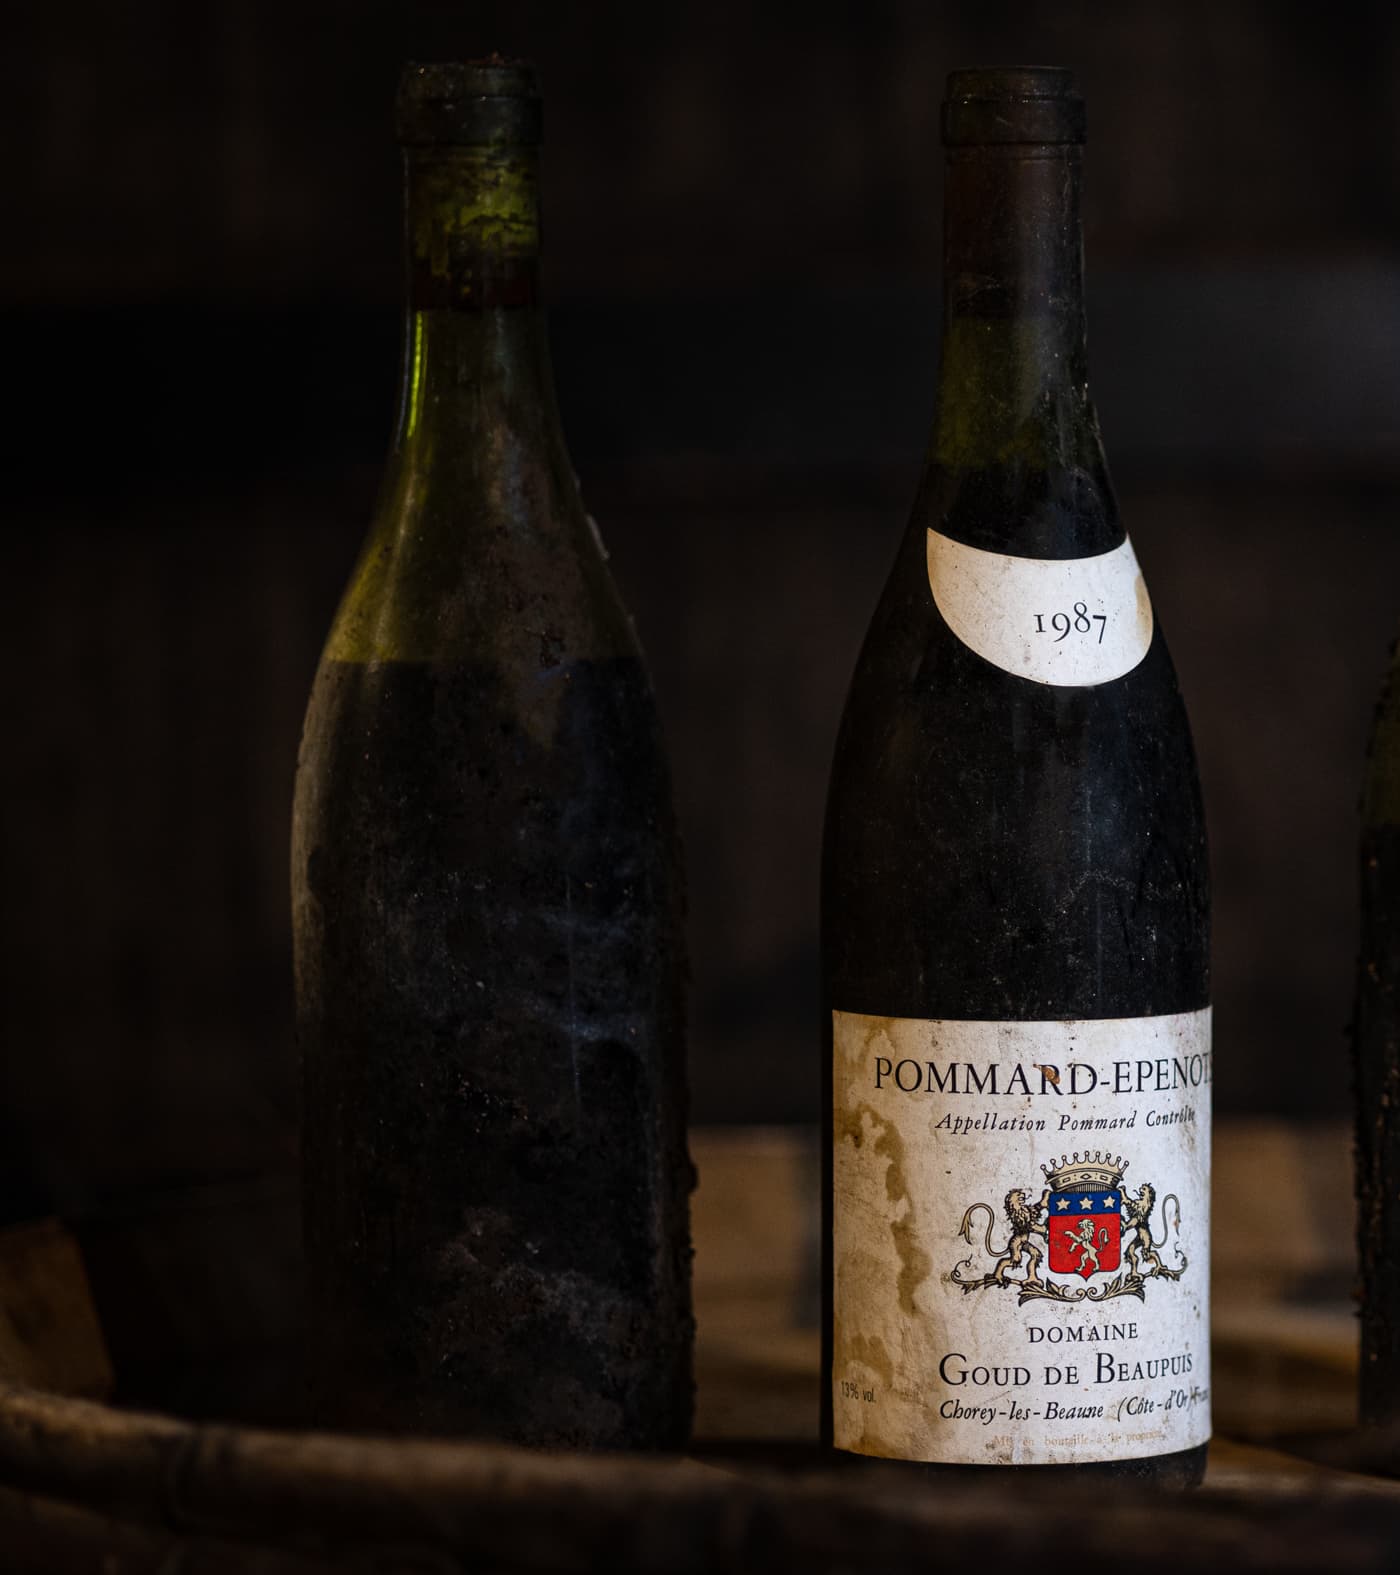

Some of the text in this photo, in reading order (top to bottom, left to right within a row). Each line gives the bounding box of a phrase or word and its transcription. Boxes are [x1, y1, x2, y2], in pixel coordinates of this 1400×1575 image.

[1033, 601, 1107, 644] 1987
[934, 1111, 1046, 1135] Appellation
[1057, 1109, 1137, 1131] Pommard
[1028, 1322, 1139, 1344] DOMAINE
[1044, 1366, 1079, 1385] DE
[1094, 1352, 1193, 1384] BEAUPUIS
[841, 1381, 859, 1400] 13%
